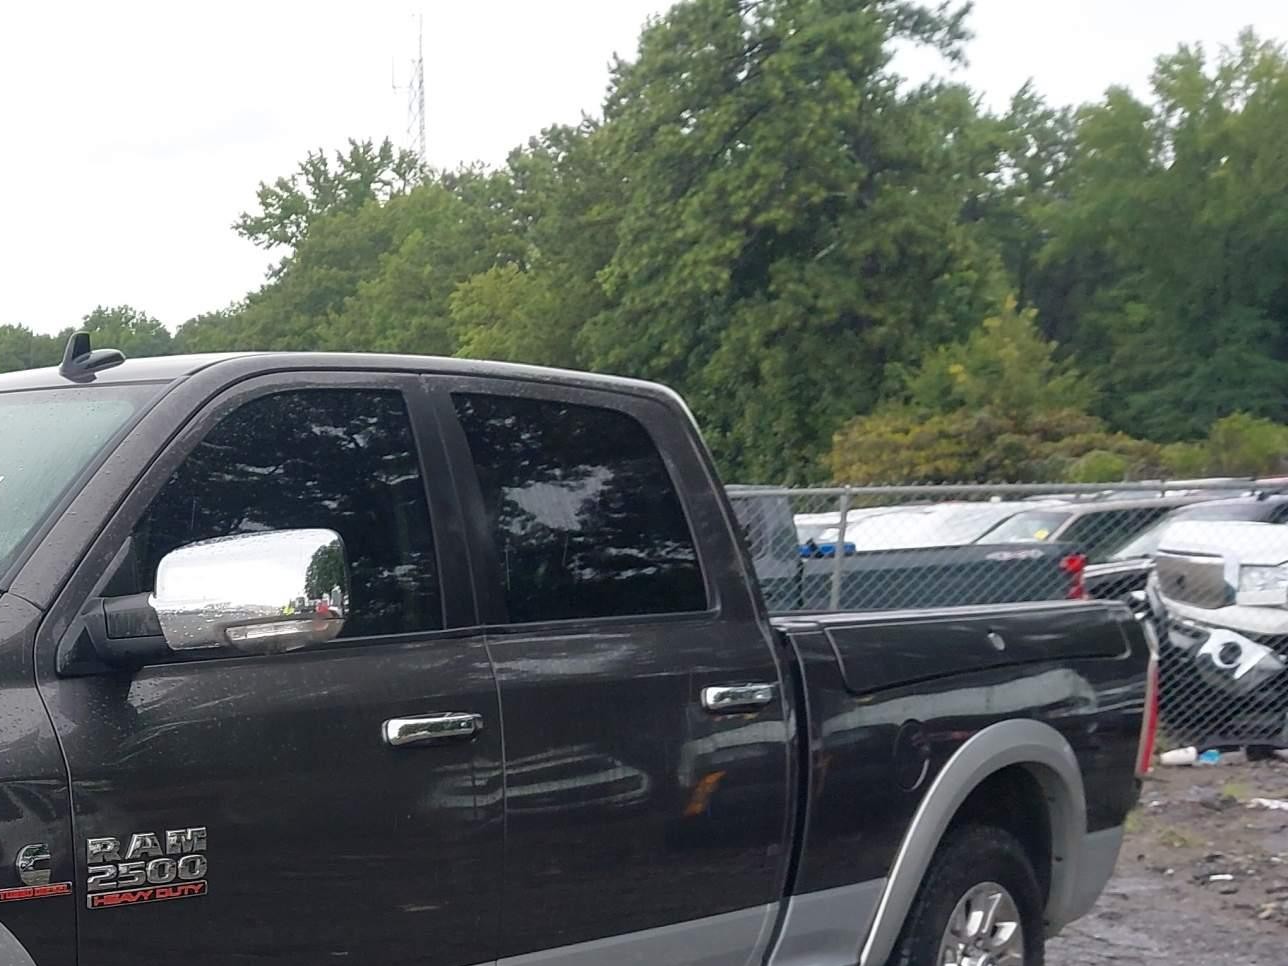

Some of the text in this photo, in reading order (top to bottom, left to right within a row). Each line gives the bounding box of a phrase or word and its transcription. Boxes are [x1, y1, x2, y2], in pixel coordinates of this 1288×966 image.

[87, 827, 207, 864] RAM
[88, 854, 207, 891] 2500
[94, 883, 205, 907] HEAVY DUTY
